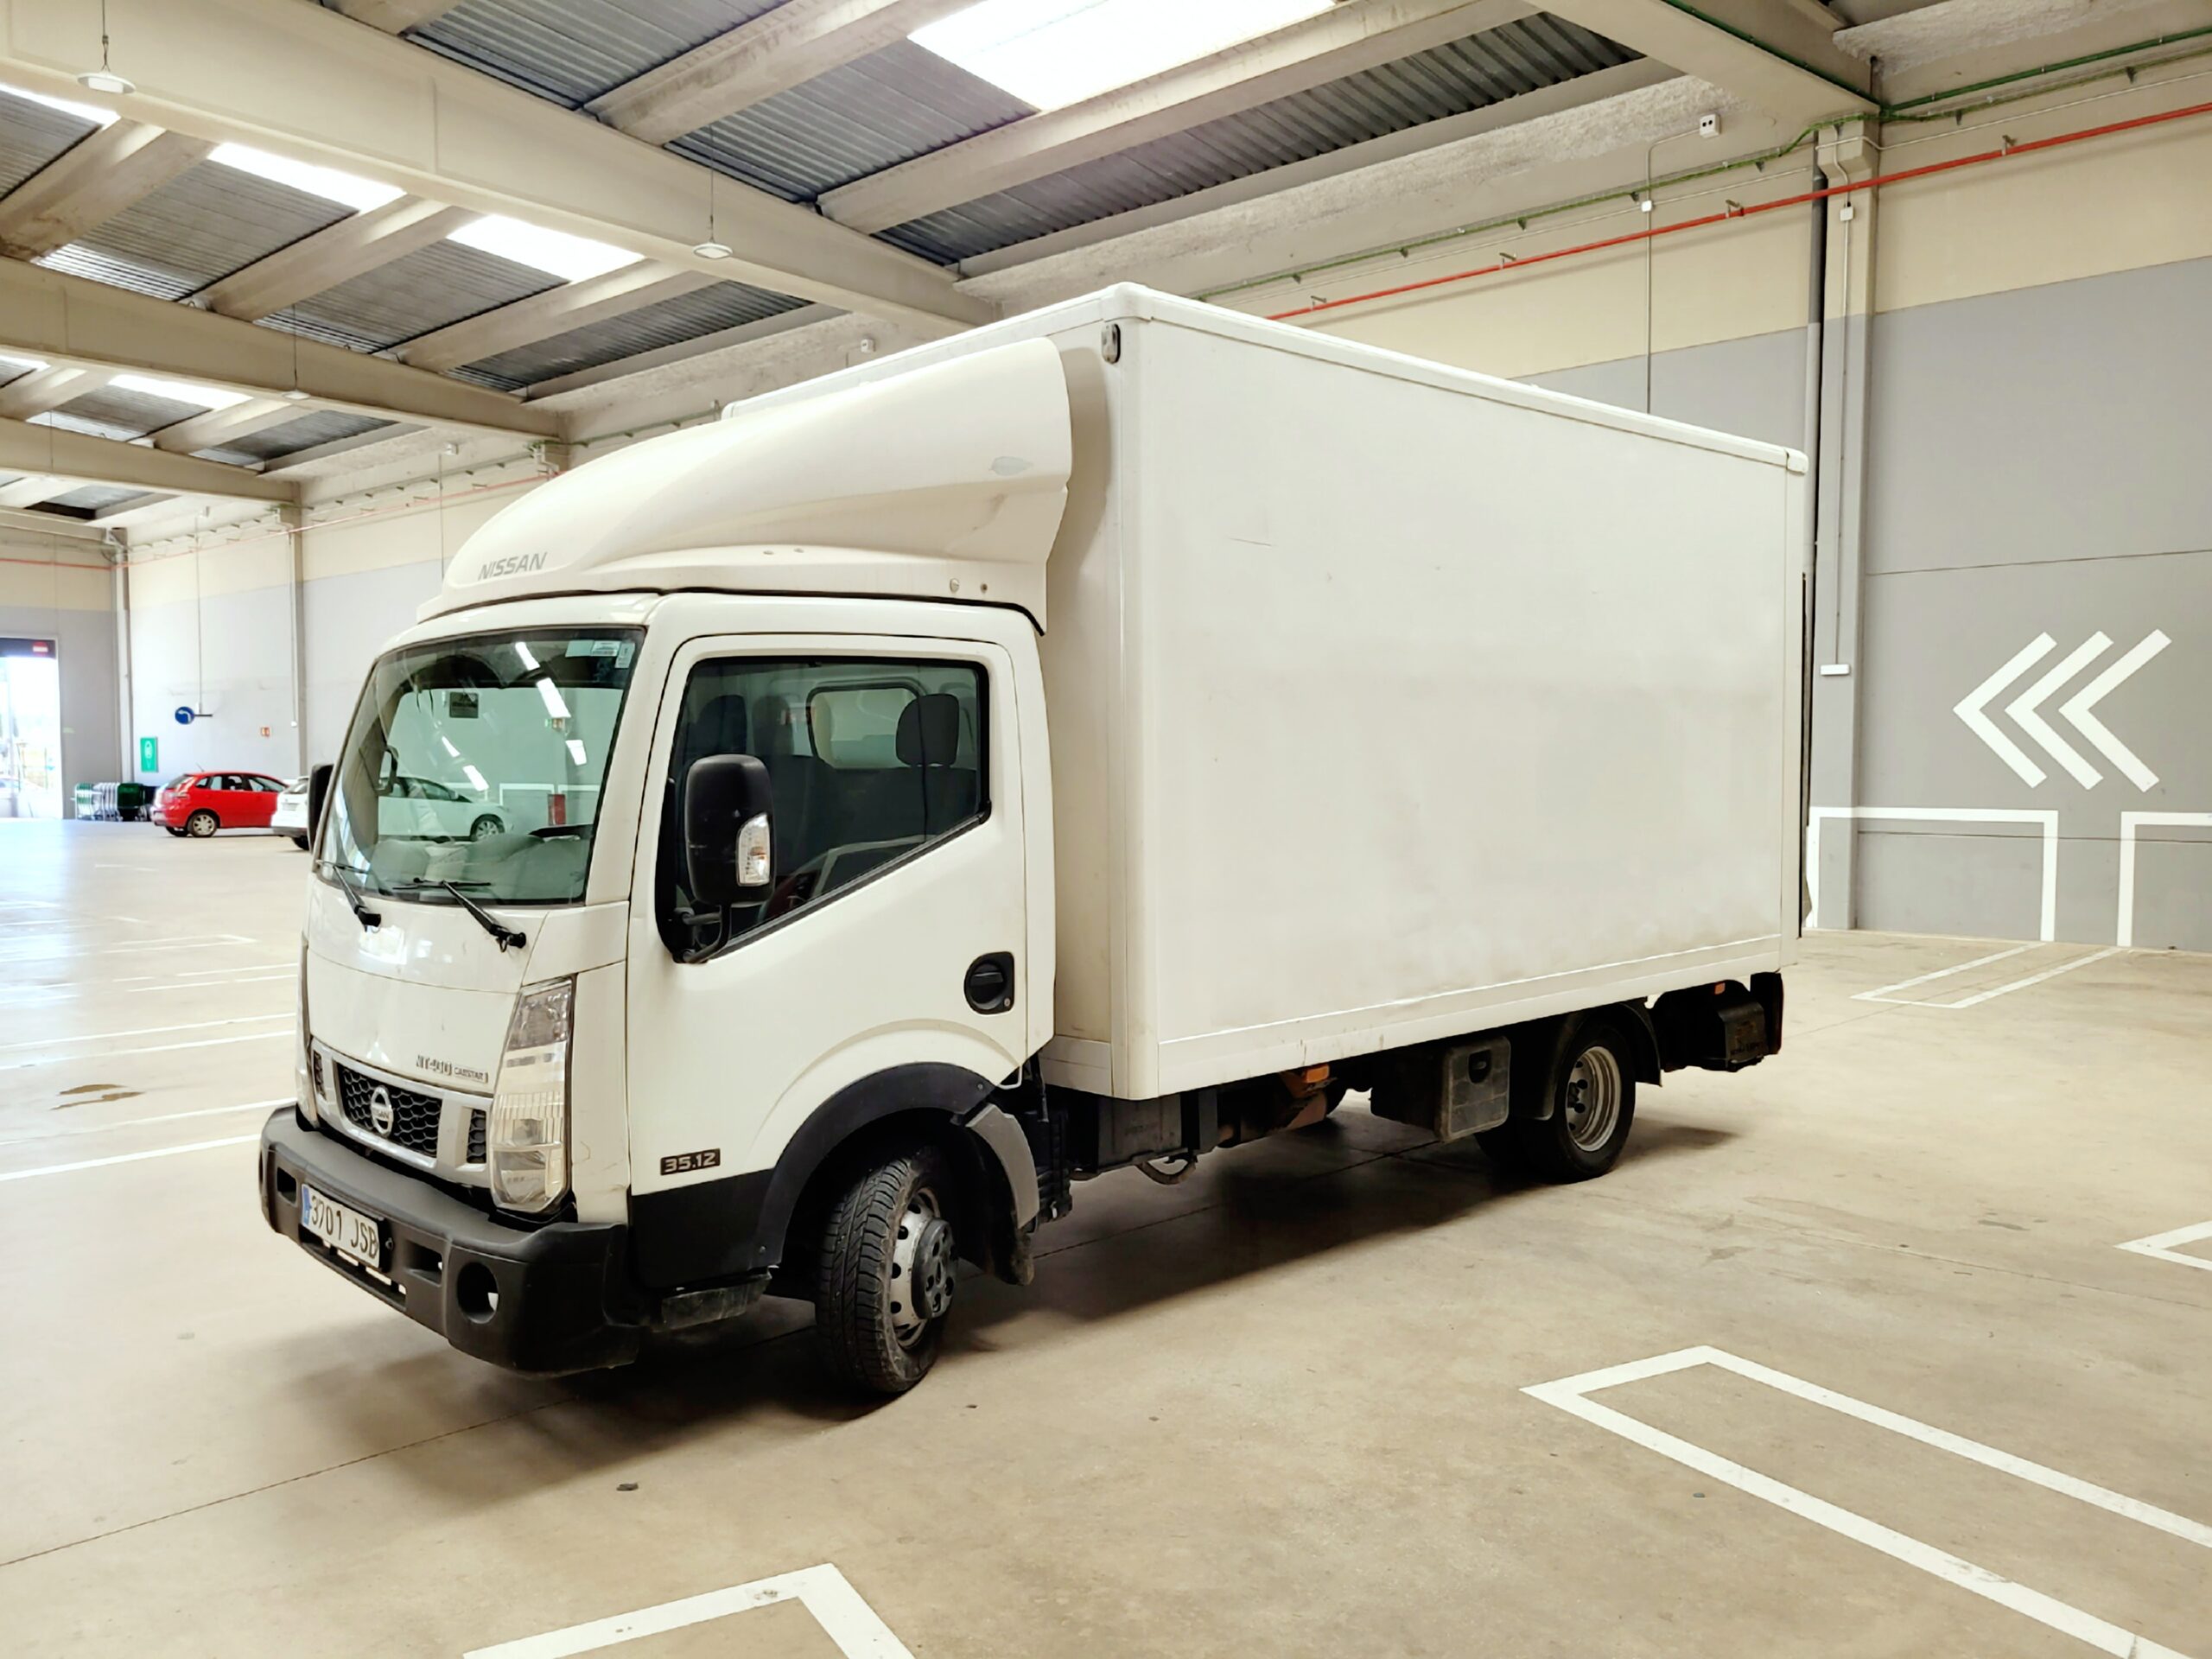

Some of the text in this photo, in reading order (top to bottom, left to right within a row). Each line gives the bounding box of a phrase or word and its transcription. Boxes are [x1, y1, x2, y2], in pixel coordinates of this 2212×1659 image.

[477, 551, 548, 581] NISSAN
[664, 1152, 716, 1173] 35.12
[350, 1217, 378, 1259] JSB
